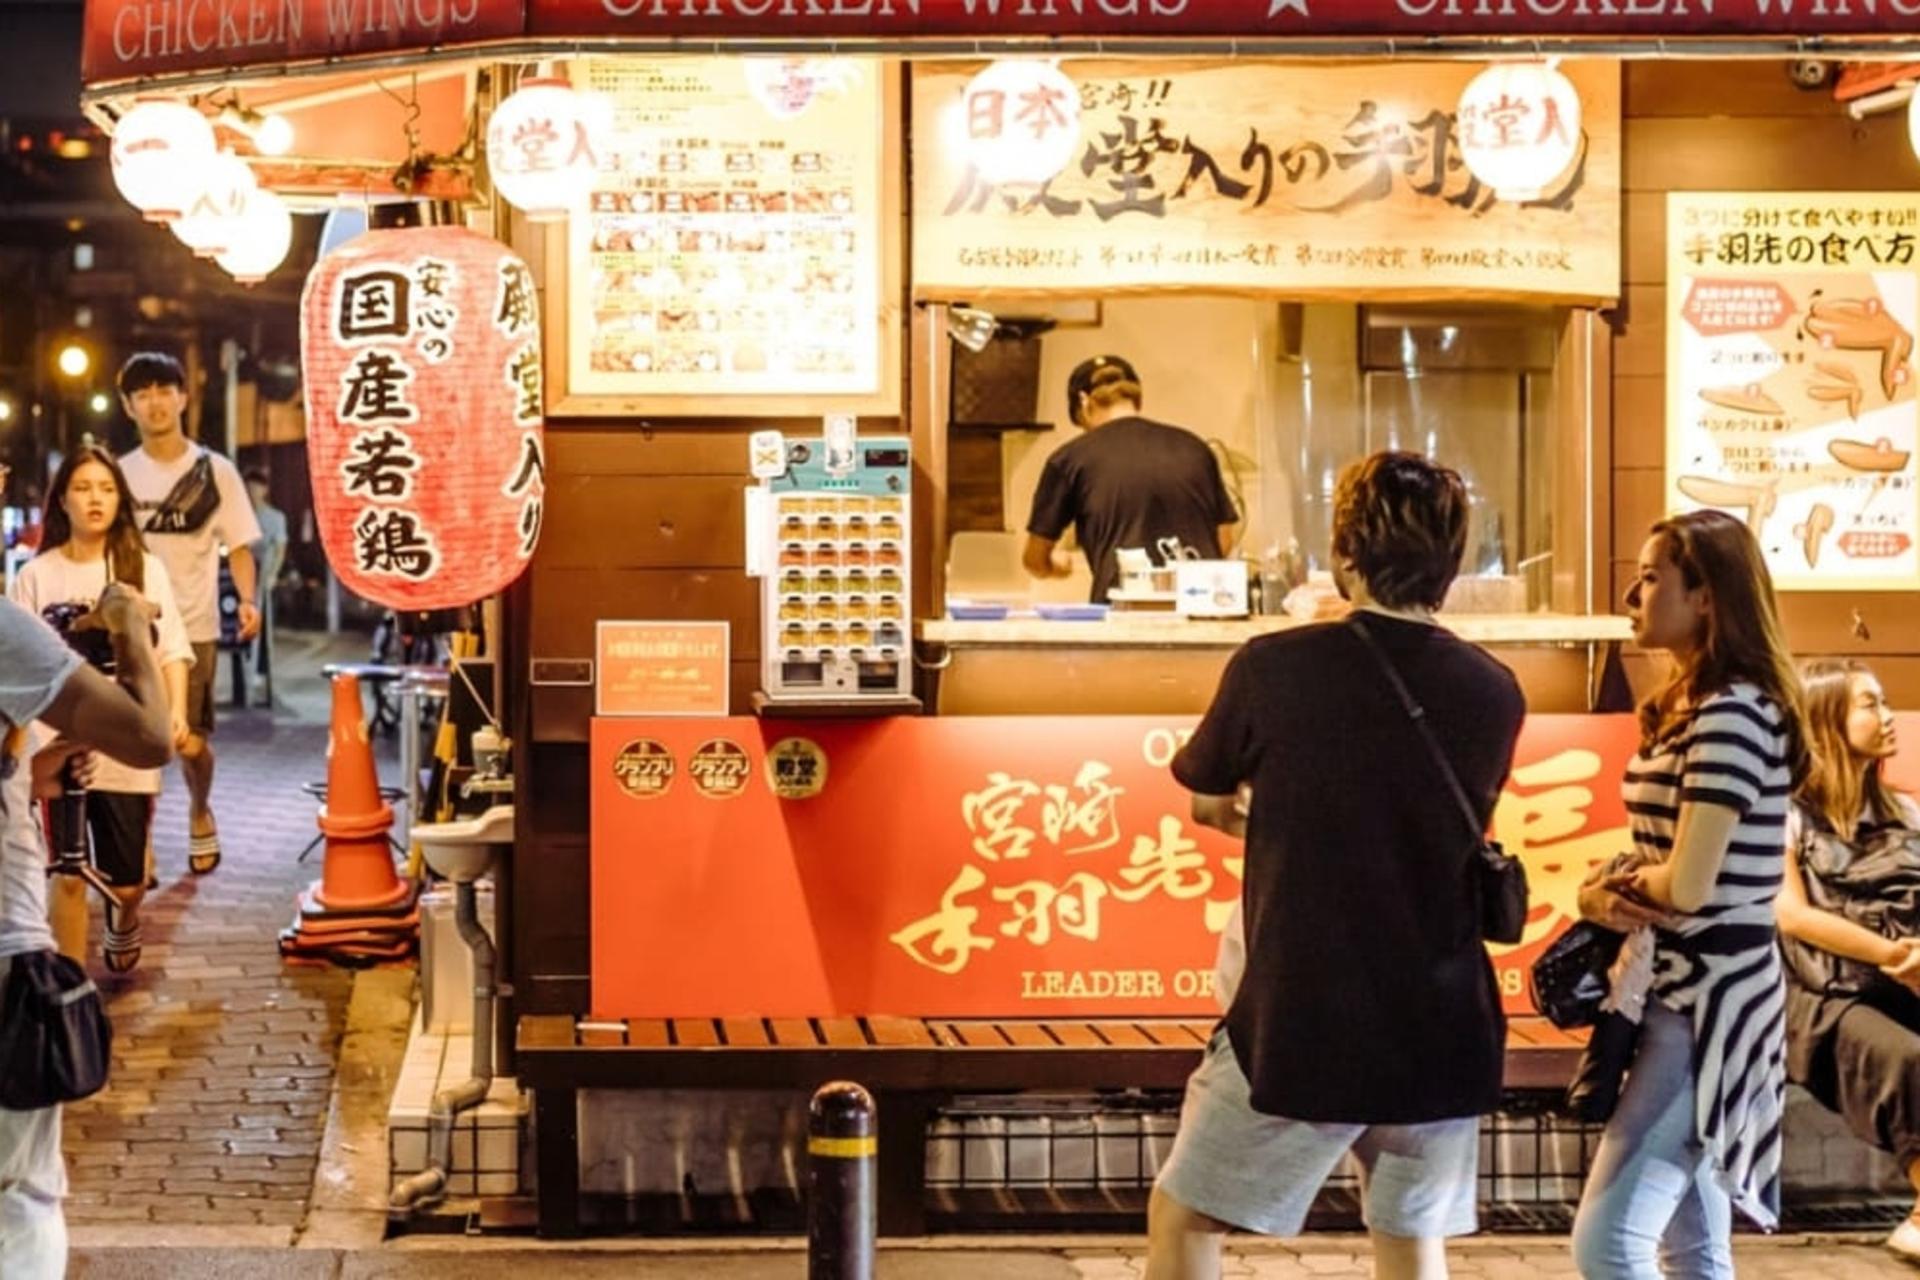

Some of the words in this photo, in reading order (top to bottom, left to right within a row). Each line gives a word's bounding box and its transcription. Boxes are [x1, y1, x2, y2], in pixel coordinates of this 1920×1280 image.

[112, 0, 300, 62] CHICKEN
[1684, 231, 1917, 265] 手羽先の食べ方
[417, 261, 454, 358] 安心の
[338, 269, 433, 578] 国産若鶏
[1021, 971, 1164, 998] LEADER
